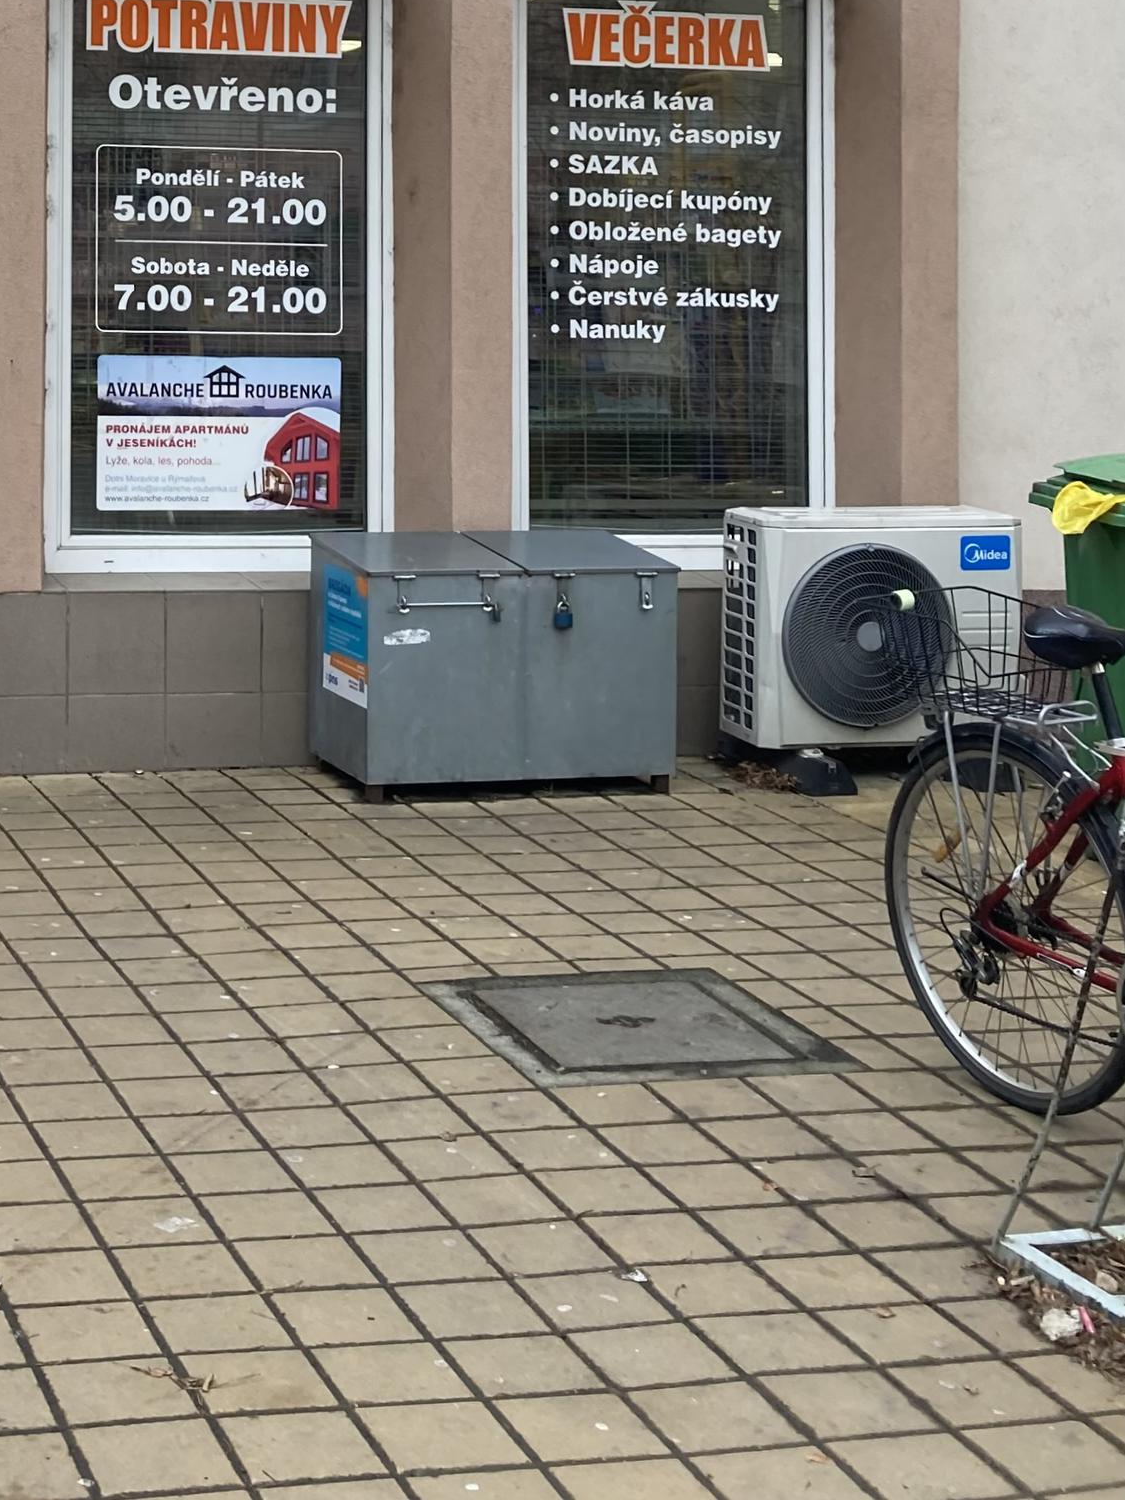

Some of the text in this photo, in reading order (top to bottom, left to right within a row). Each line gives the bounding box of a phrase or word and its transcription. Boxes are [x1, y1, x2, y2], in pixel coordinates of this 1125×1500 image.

[568, 5, 766, 69] VEČERKA
[108, 74, 338, 114] Otevřeno:
[569, 88, 714, 112] Horká káva
[569, 121, 782, 149] Noviny, časopisy
[568, 153, 659, 176] SAZKA
[136, 167, 221, 187] Pondělí
[240, 170, 305, 189] Pátek
[113, 194, 193, 223] 5.00
[227, 197, 327, 226] 21.00
[568, 187, 773, 215] Dobíjecí kupóny
[568, 220, 782, 248] Obložené bagety
[130, 256, 210, 276] Sobota
[231, 258, 310, 278] Neděle
[569, 253, 659, 277] Nápoje
[113, 283, 192, 312] 7.00
[227, 285, 327, 315] 21.00
[568, 280, 780, 312] Čerstvé zákusky
[569, 319, 666, 343] Nanuky
[106, 382, 333, 400] AVALANCHE ROUBENKA
[105, 423, 171, 434] PRONÁJEM
[106, 437, 197, 448] V JESENÍKÁCH!
[105, 456, 129, 466] Lyže,
[133, 456, 154, 466] kola,
[158, 456, 174, 466] les,
[104, 495, 210, 503] www.avalanche-roubenka.cz
[970, 547, 1008, 562] Midea
